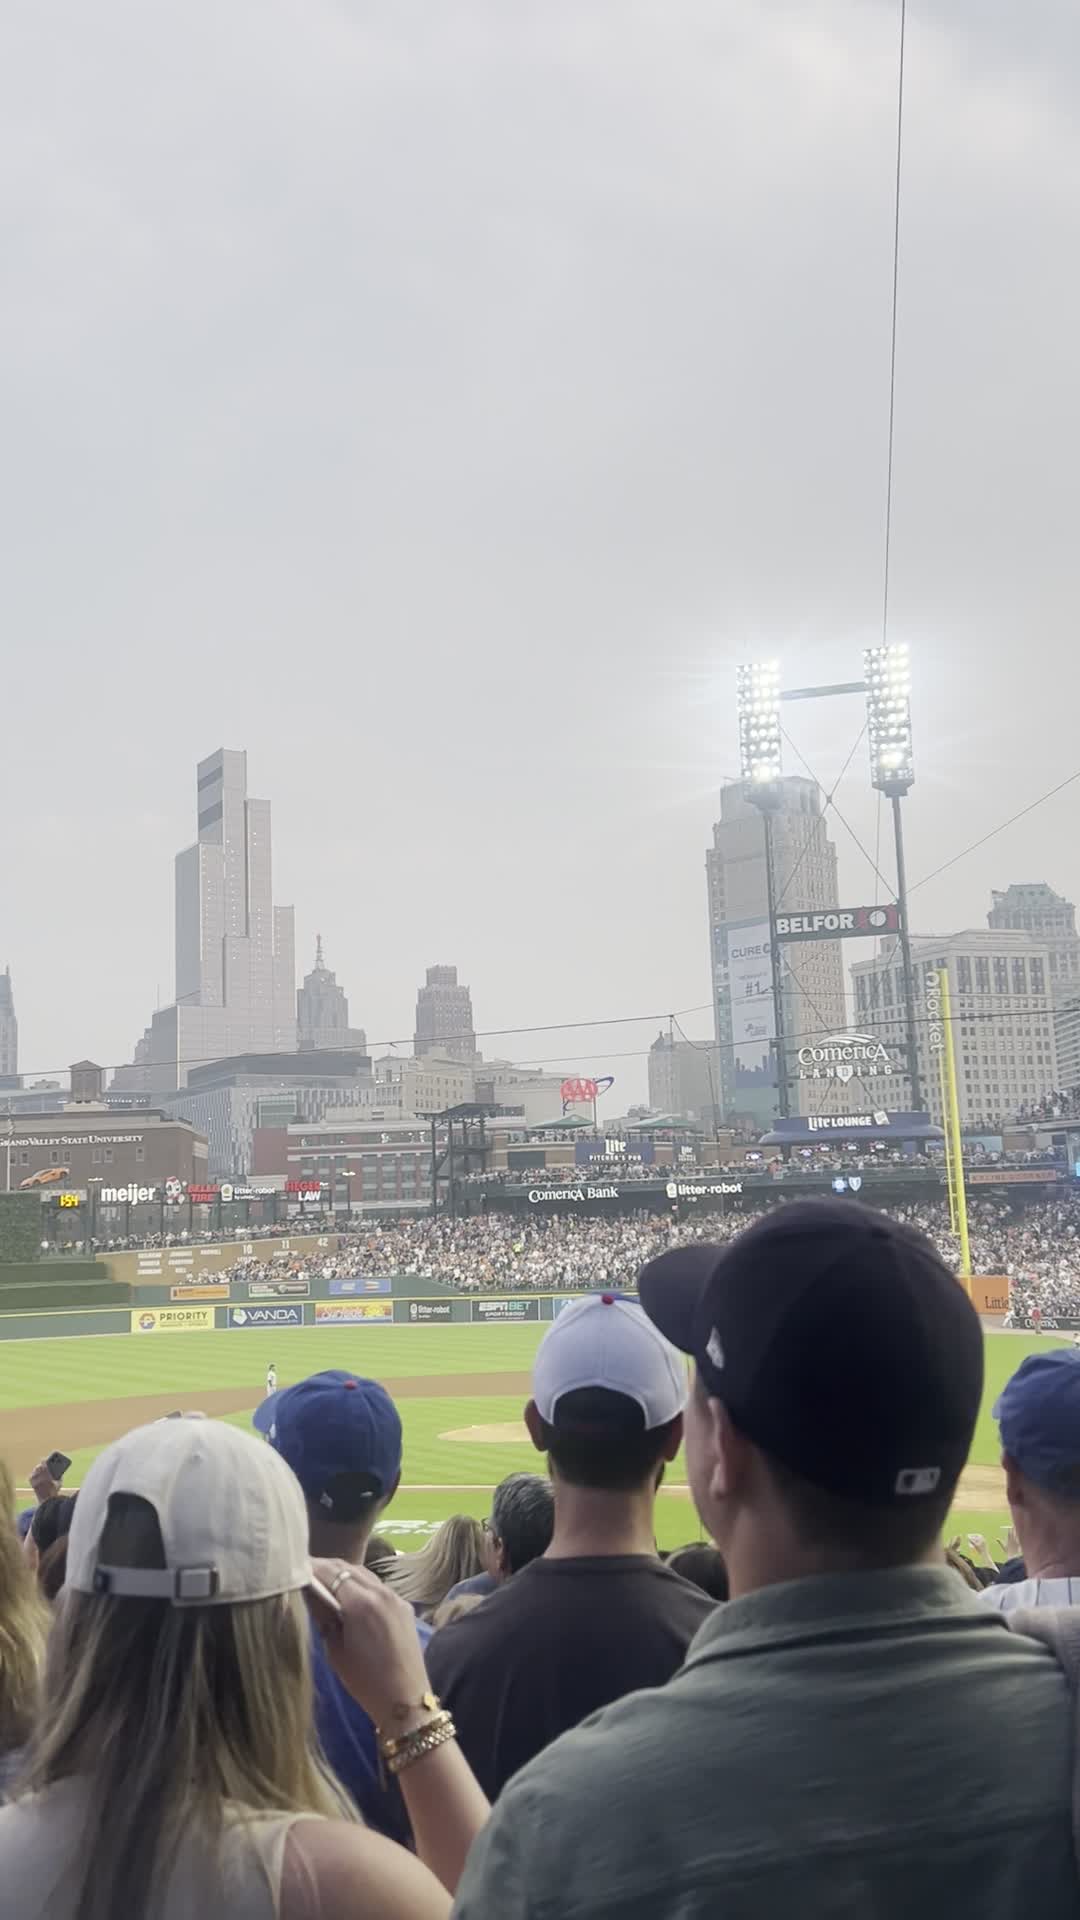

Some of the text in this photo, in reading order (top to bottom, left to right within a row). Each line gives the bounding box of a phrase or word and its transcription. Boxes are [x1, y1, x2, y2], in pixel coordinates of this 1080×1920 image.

[776, 913, 854, 934] BELFOR
[731, 946, 762, 958] CURE
[927, 989, 945, 1051] Rocket
[563, 1081, 594, 1098] AAA
[808, 1115, 872, 1131] Lite LOUNGE
[61, 1136, 89, 1144] STATE
[89, 1135, 144, 1144] UNIVERSITY
[605, 1139, 627, 1155] Lite
[101, 1184, 156, 1205] meijer
[298, 1191, 320, 1201] LAW
[588, 1186, 619, 1199] Bank
[508, 1302, 531, 1311] BET
[985, 1296, 1008, 1309] Little
[159, 1311, 208, 1321] PRIORITY
[247, 1309, 297, 1320] VANDA
